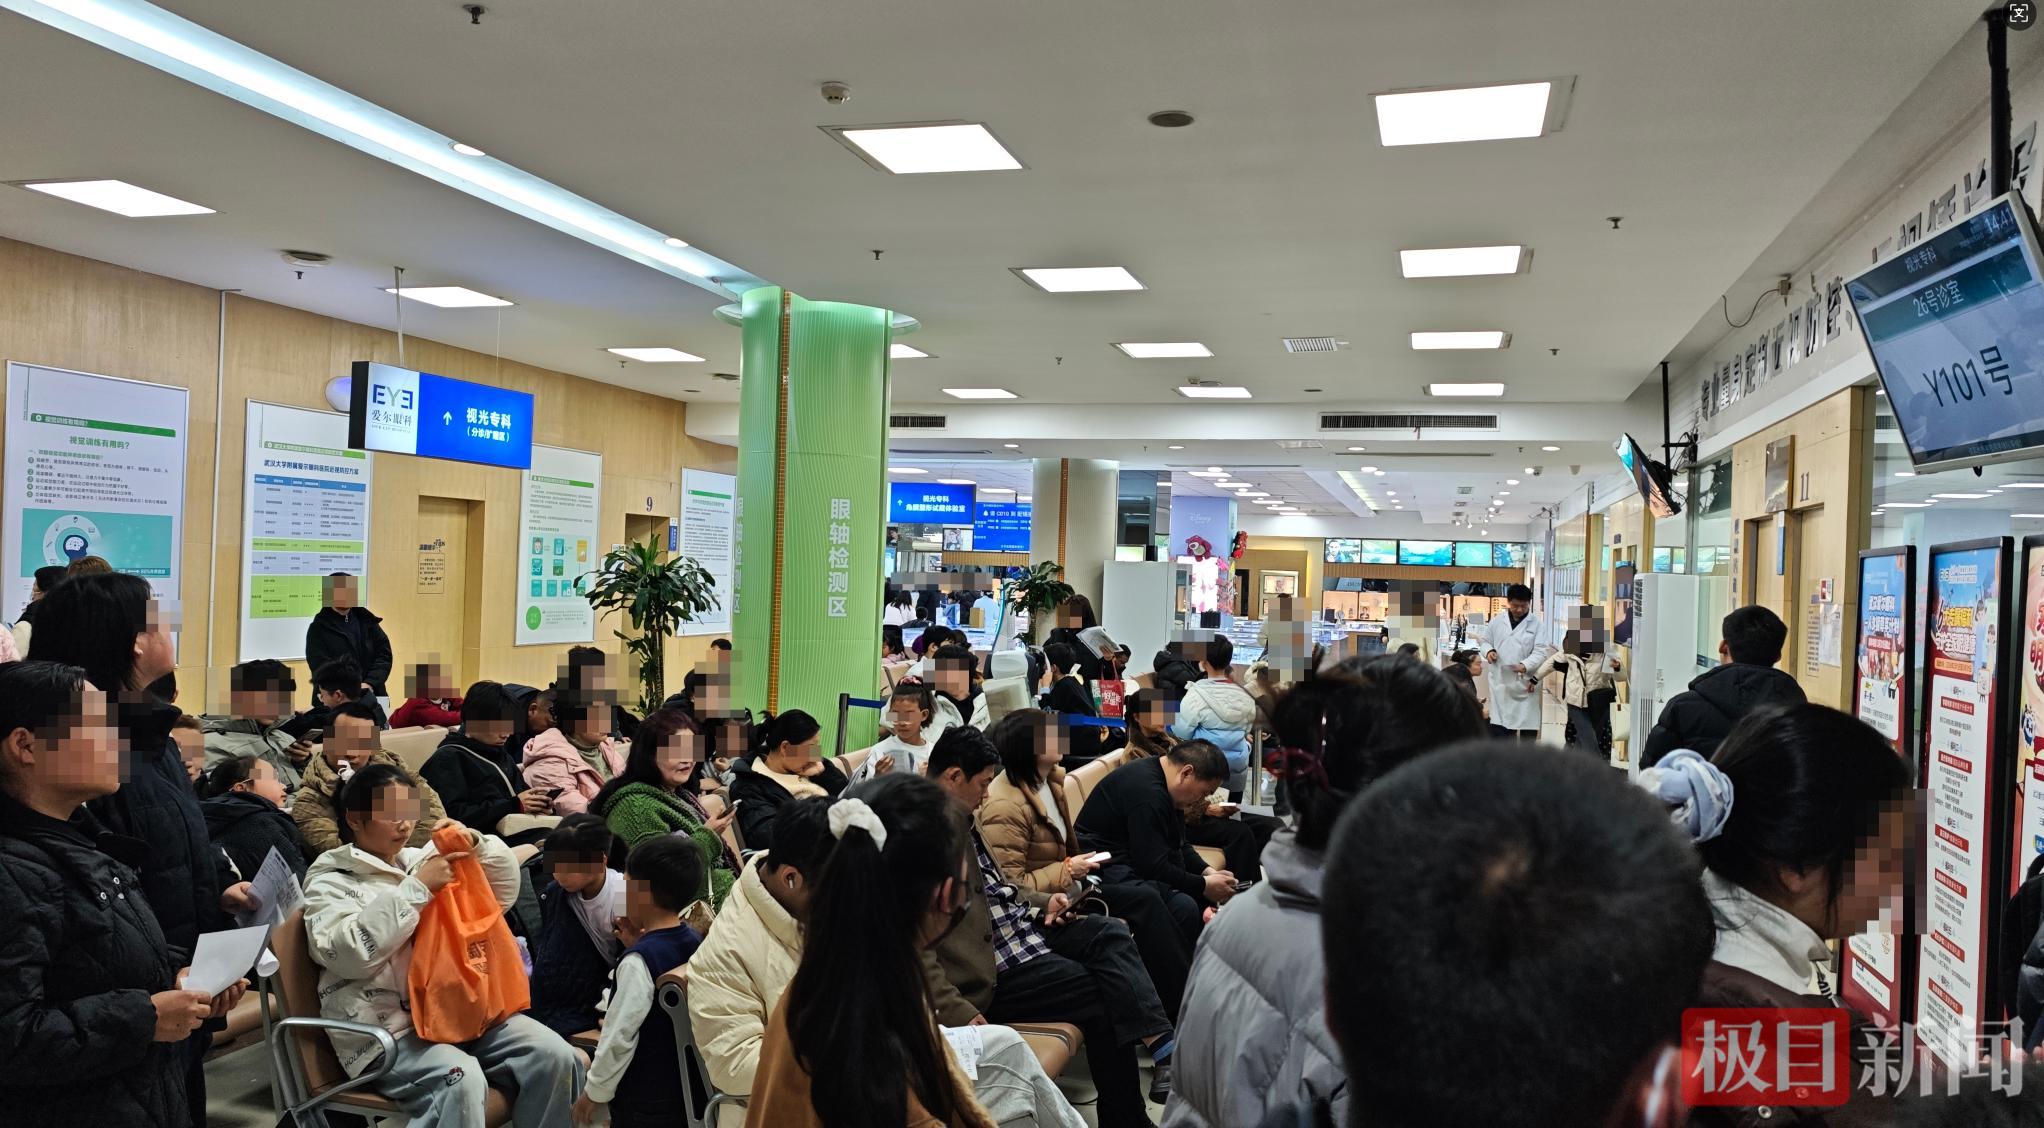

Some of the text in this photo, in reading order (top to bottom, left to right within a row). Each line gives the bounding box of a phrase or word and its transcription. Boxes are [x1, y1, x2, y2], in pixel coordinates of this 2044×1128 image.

[1905, 247, 1937, 273] 视光专科
[1912, 280, 1964, 317] 26号诊室
[1922, 345, 2013, 408] Y101号
[373, 384, 413, 410] EYE
[372, 409, 412, 428] 爱尔眼科
[466, 407, 512, 430] 视光专科
[1800, 471, 1809, 502] 11
[646, 496, 653, 512] 9
[828, 498, 851, 617] 眼轴检测区
